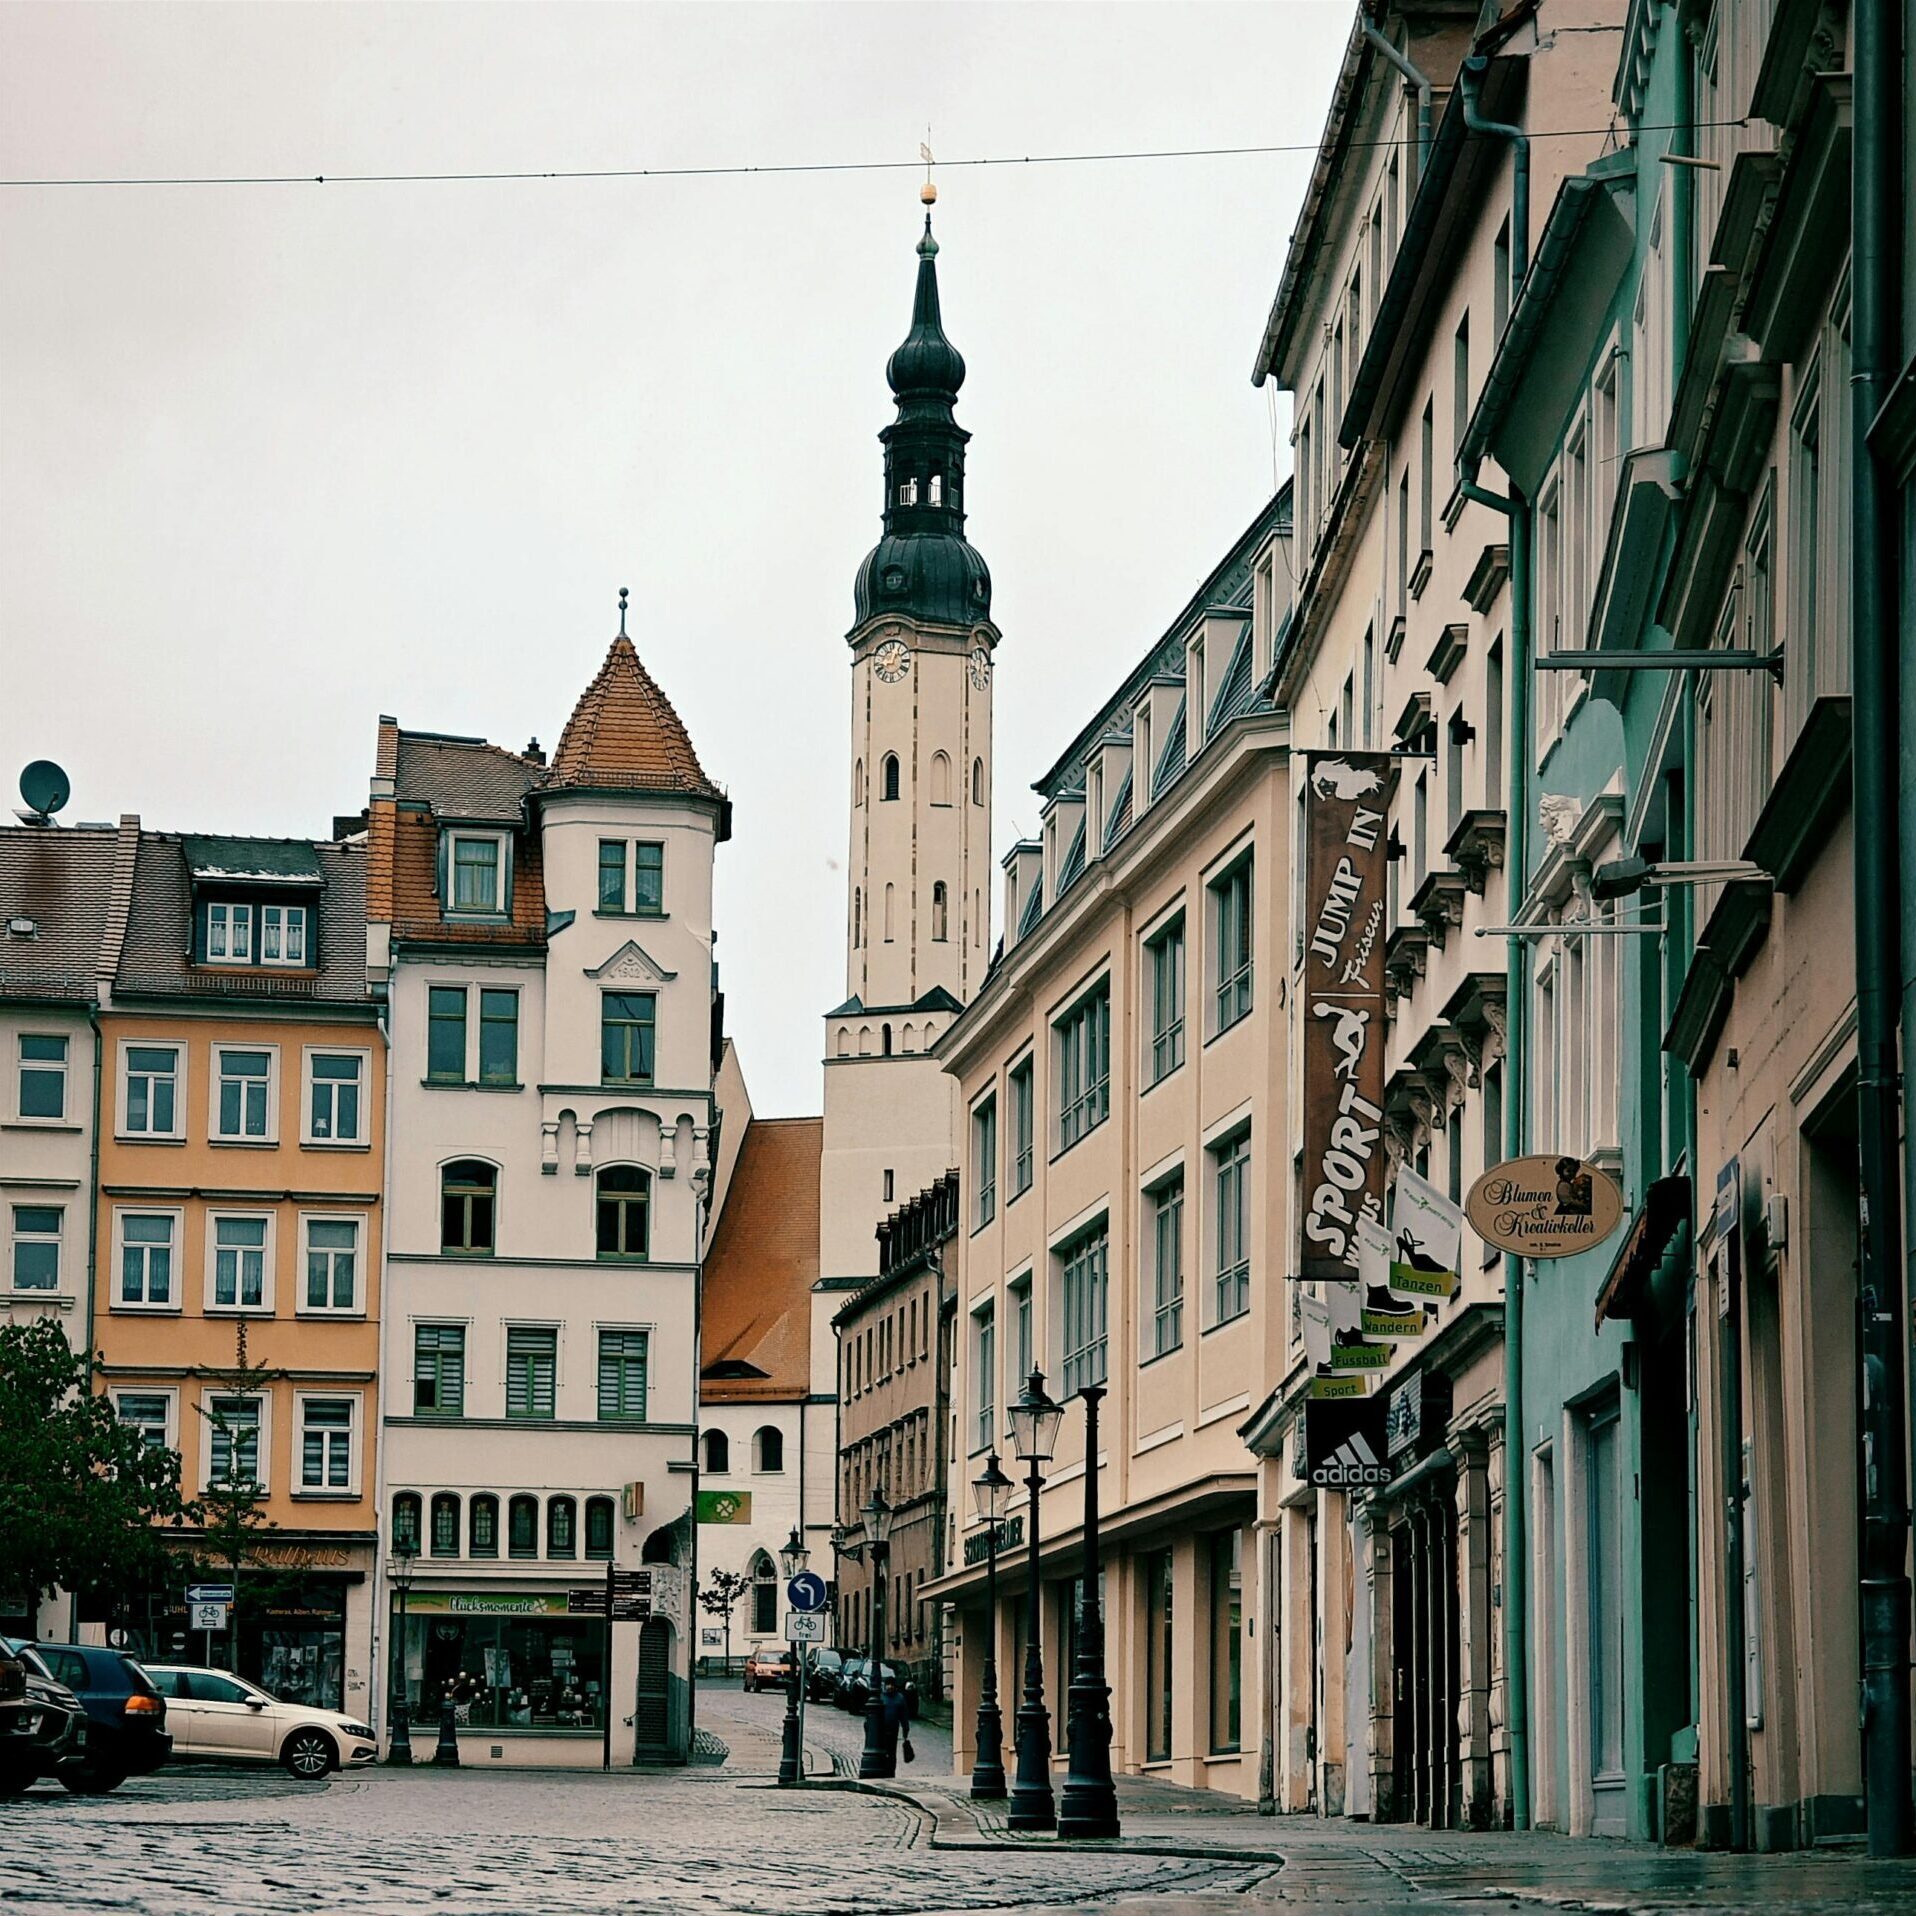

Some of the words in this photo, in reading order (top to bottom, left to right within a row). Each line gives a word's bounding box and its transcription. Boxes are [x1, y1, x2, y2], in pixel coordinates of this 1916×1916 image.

[1310, 856, 1363, 968] JUMP
[1346, 805, 1384, 851] IN
[1339, 899, 1384, 989] Friseur
[1306, 1082, 1383, 1257] SPORT
[1484, 1178, 1552, 1206] Blumen
[1531, 1203, 1548, 1220] &
[1494, 1210, 1594, 1238] Kreativkeller
[1395, 1276, 1442, 1293] Tanzen
[1364, 1321, 1417, 1333] Wandern
[1335, 1354, 1388, 1366] Fussball
[1324, 1385, 1357, 1397] Sport
[1313, 1464, 1391, 1484] adidas
